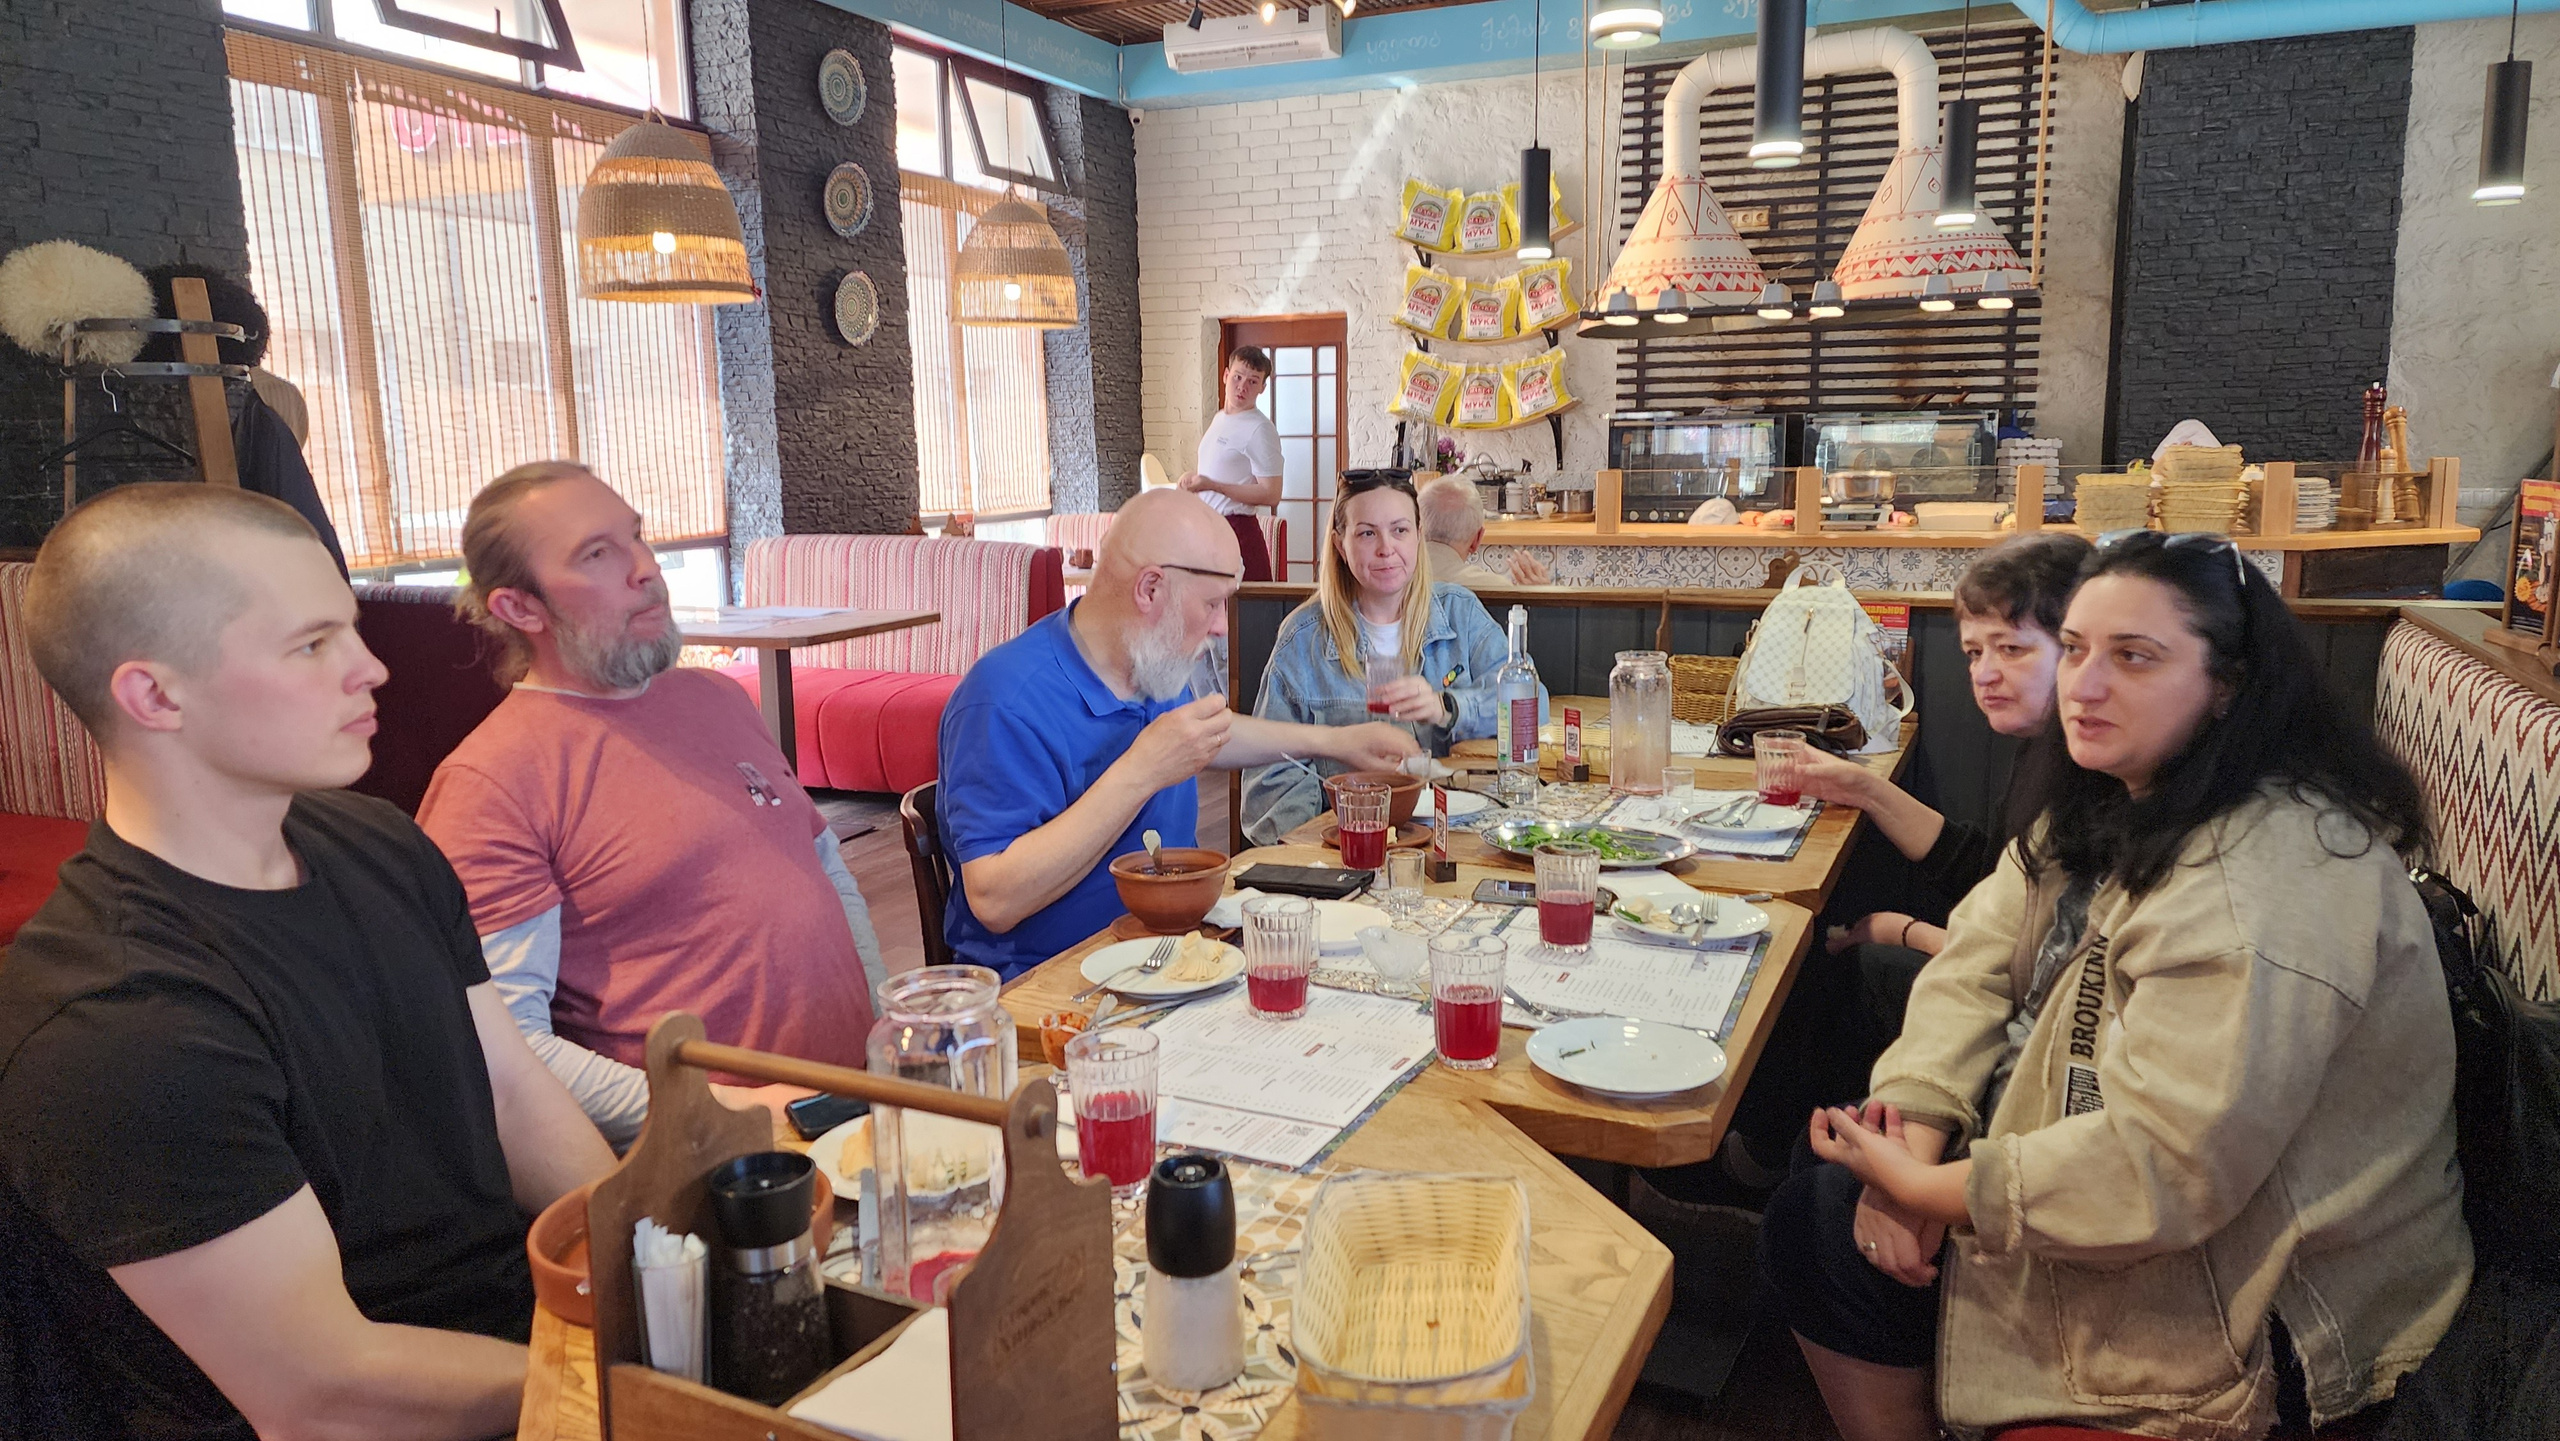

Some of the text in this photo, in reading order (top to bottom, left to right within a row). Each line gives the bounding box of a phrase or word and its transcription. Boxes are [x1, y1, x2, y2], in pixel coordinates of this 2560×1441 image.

[1409, 218, 1437, 231] МУКА
[1465, 227, 1493, 238] МУКА
[1407, 302, 1433, 317] МУКА
[1531, 296, 1557, 312] МУКА
[1469, 318, 1497, 326] МУКА
[1406, 390, 1432, 405] МУКА
[1521, 387, 1548, 403] МУКА
[1464, 400, 1492, 409] МУКА
